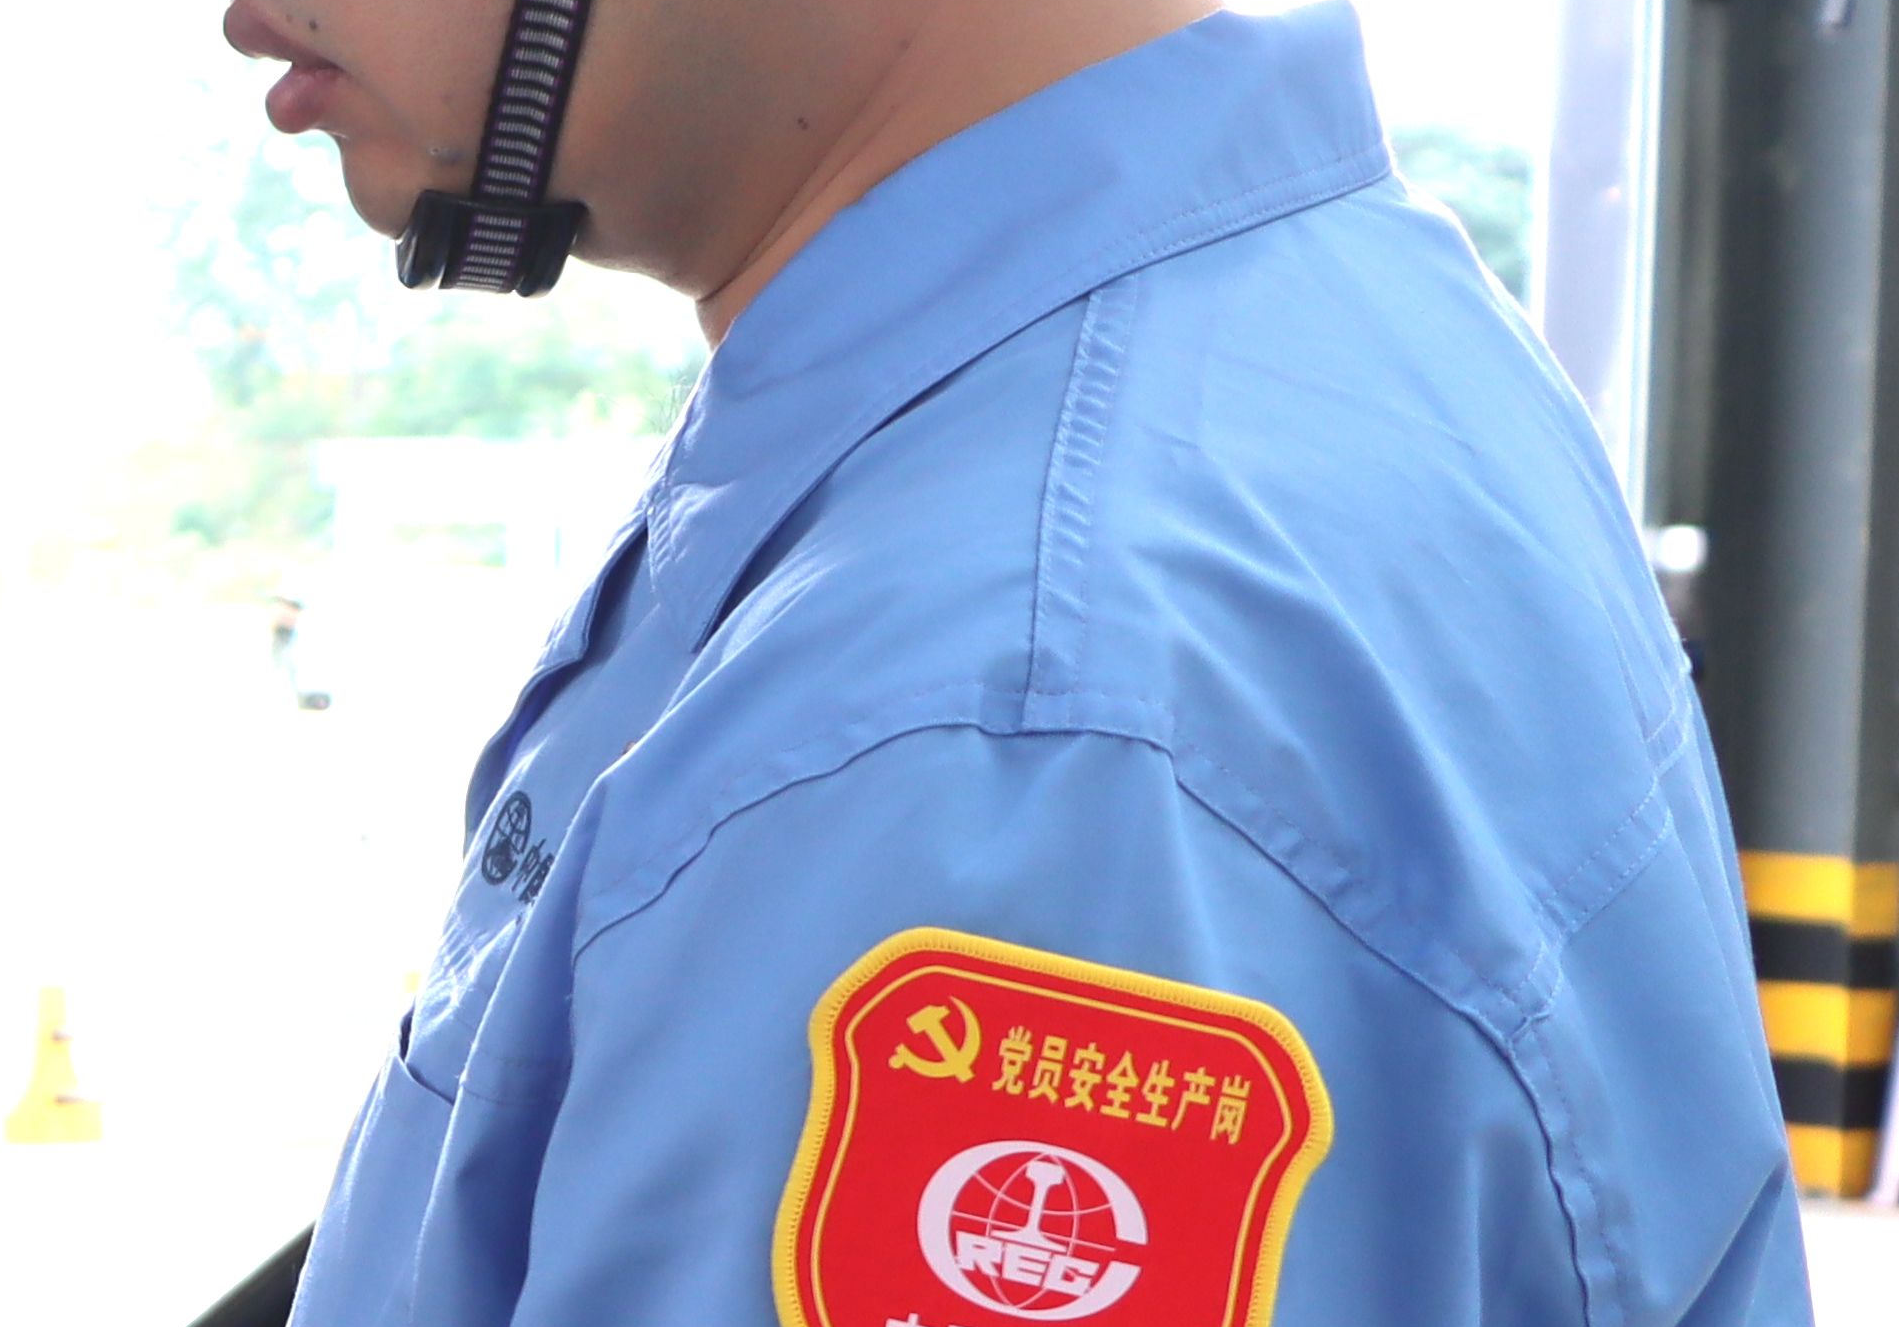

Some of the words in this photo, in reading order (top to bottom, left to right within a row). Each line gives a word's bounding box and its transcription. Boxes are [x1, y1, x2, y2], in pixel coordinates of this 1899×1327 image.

[992, 1025, 1250, 1145] 党员安全生产岗
